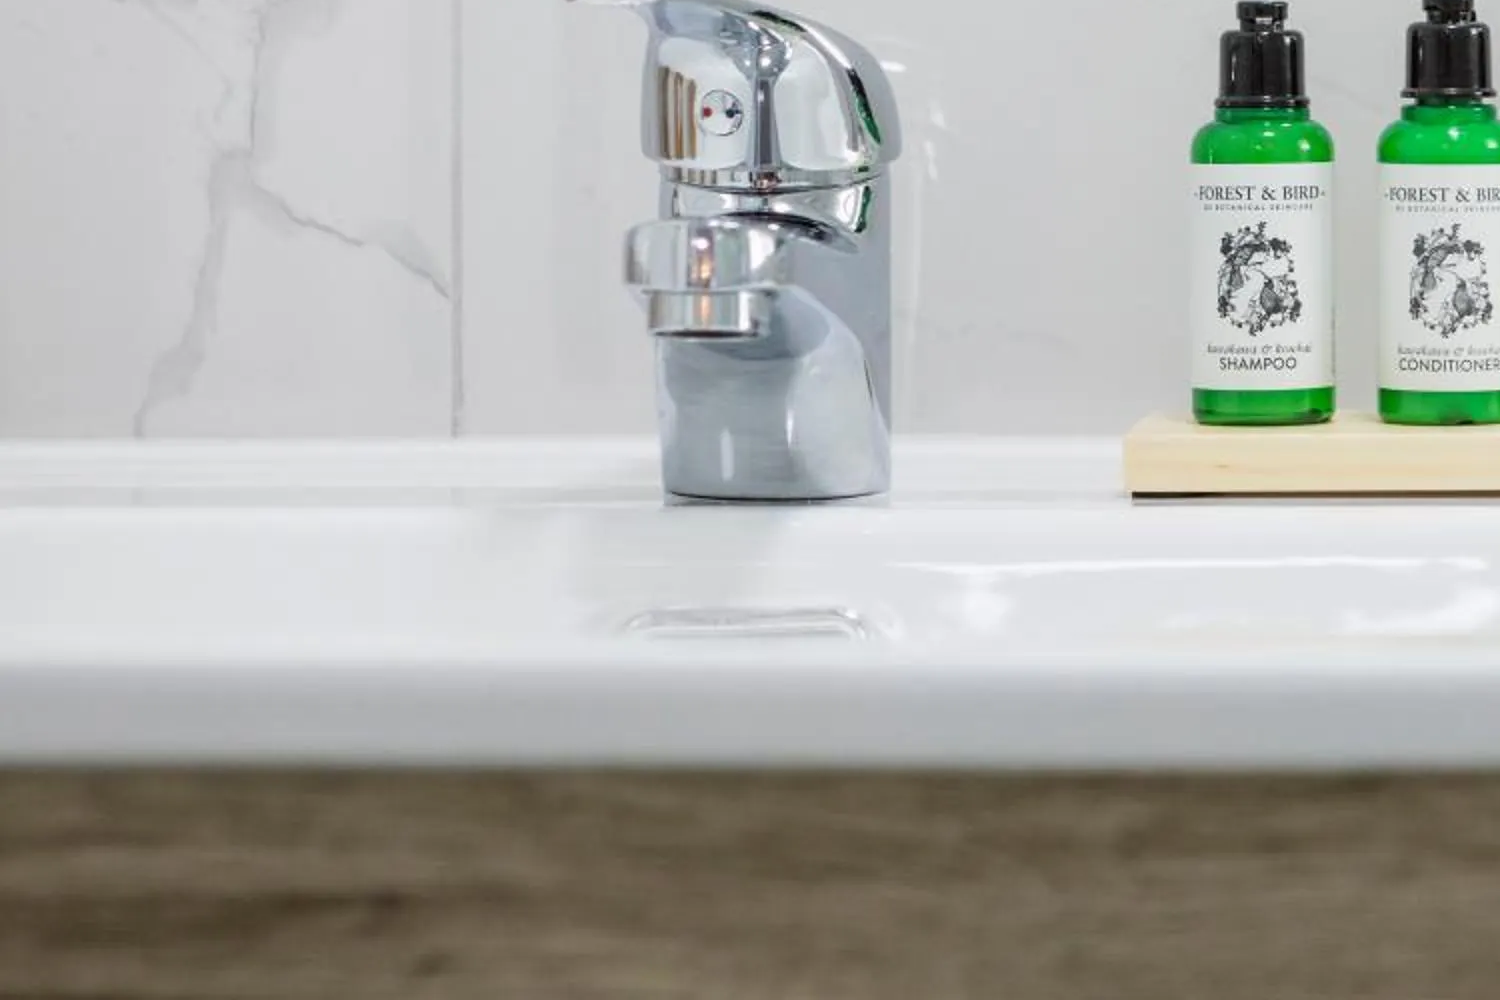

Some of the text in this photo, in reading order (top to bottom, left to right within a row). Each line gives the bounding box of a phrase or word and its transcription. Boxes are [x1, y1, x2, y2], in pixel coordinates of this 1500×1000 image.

[1199, 185, 1320, 201] FOREST & BIRD
[1389, 187, 1451, 202] FOREST
[1455, 188, 1471, 203] &
[1219, 357, 1297, 371] SHAMPOO
[1398, 358, 1500, 373] CONDITIONER
